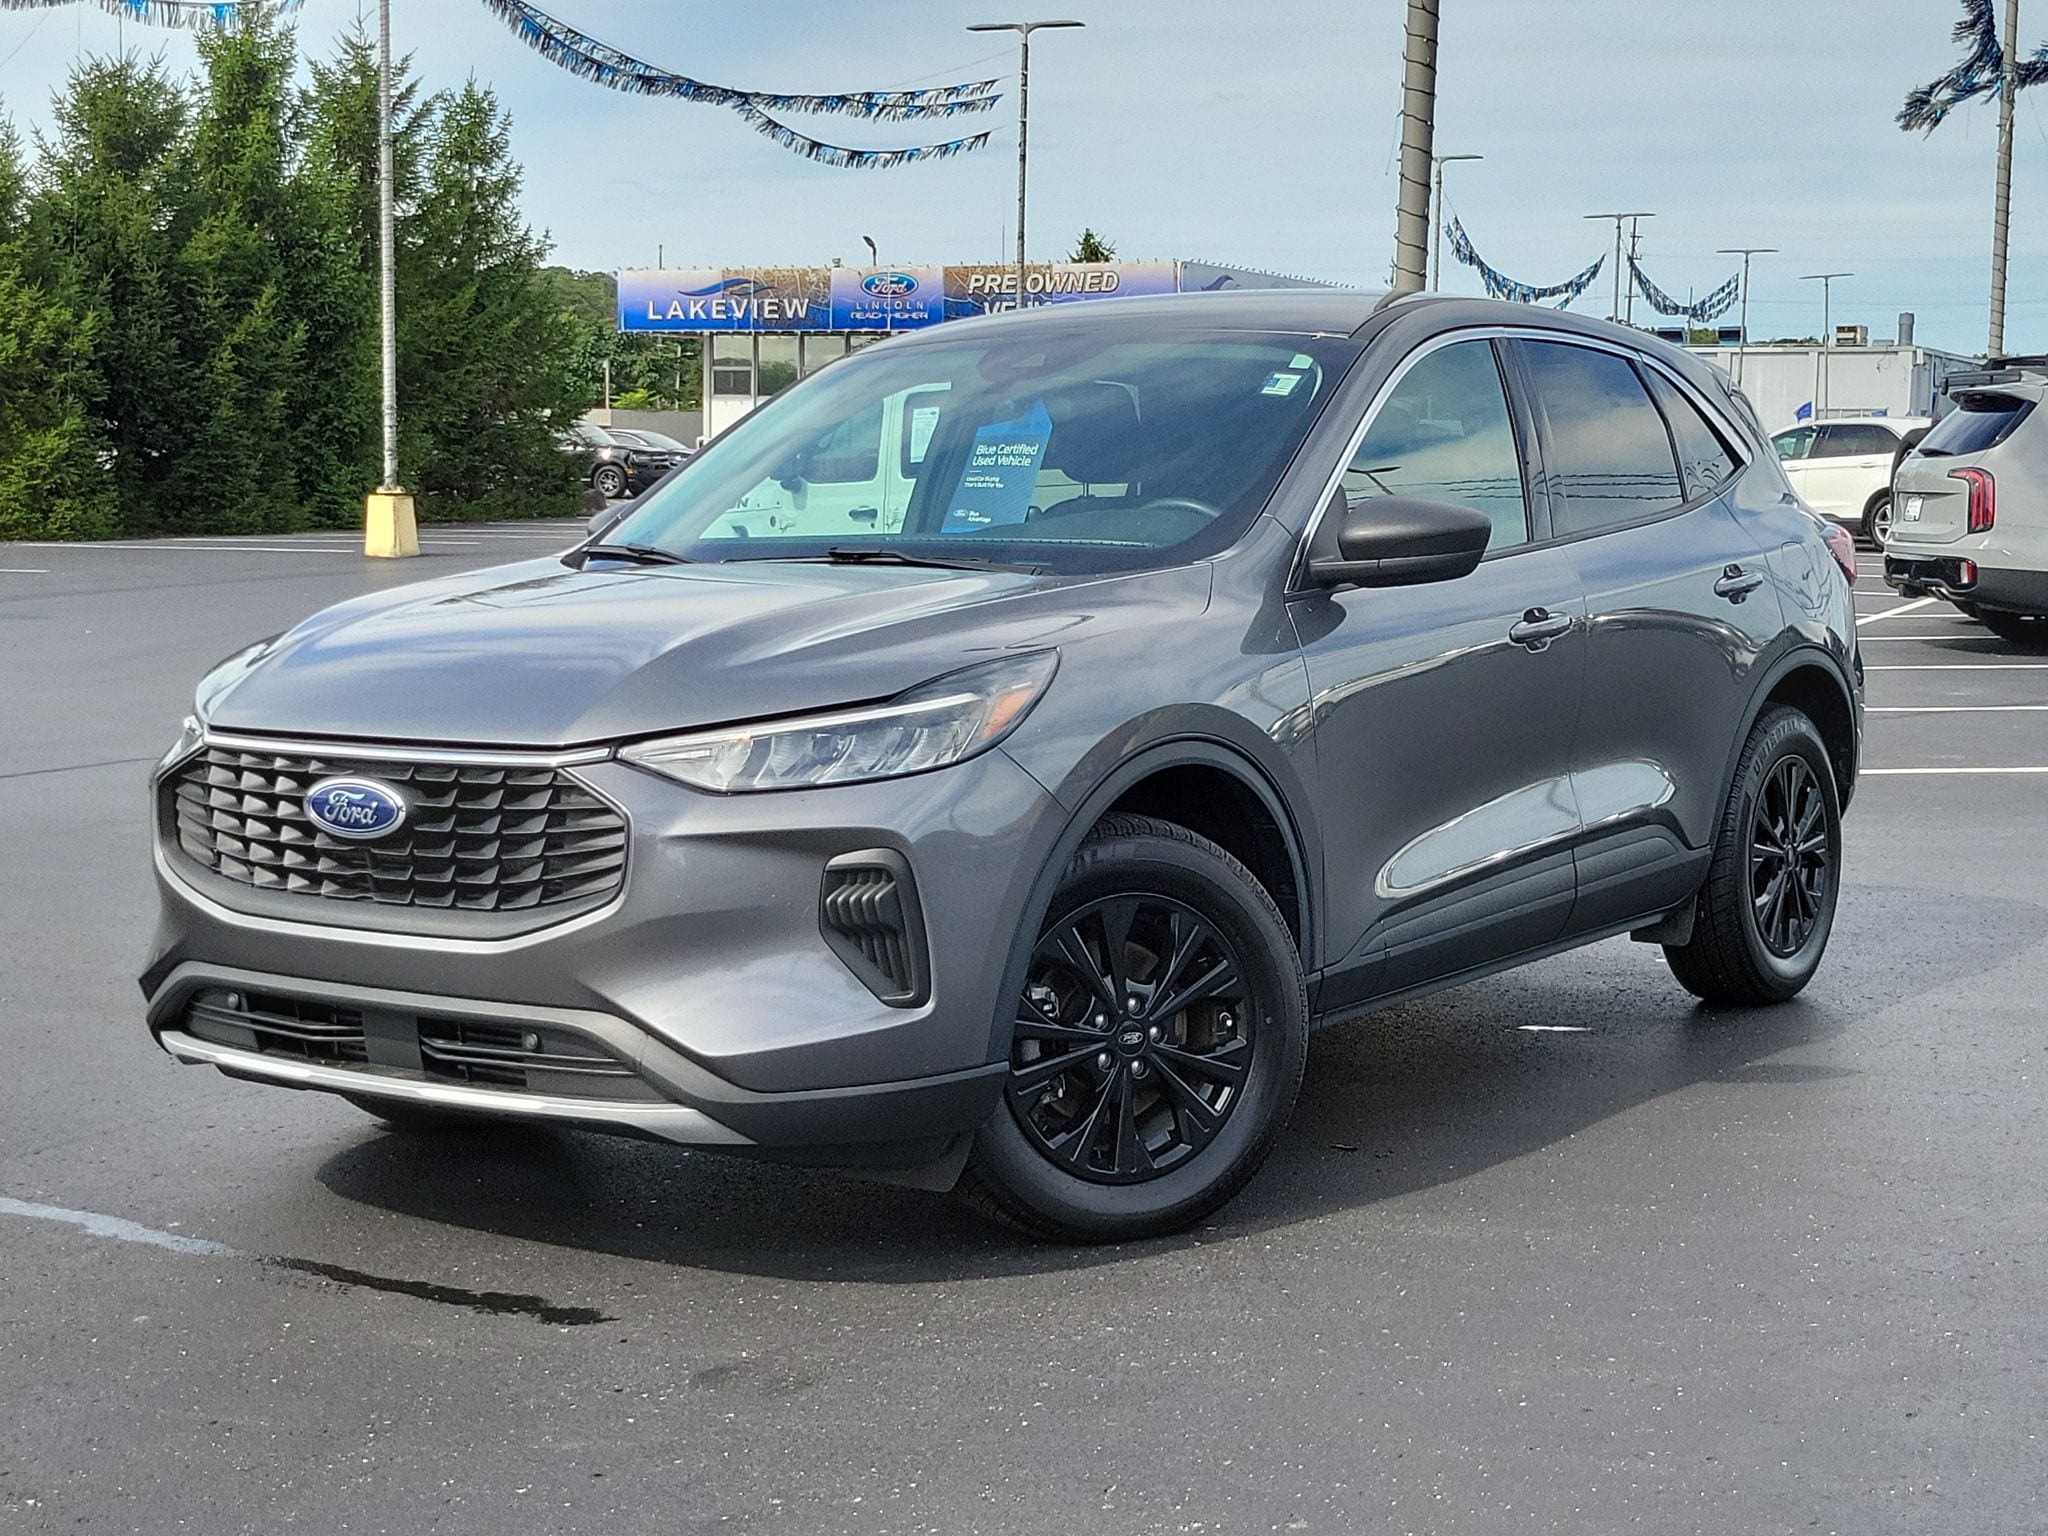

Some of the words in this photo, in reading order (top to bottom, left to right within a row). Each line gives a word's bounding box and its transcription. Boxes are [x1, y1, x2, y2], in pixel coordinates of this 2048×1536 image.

[870, 275, 908, 295] Ford
[967, 274, 1018, 295] PRE
[1025, 271, 1120, 293] OWNED
[647, 298, 811, 321] LAKEVIEW
[855, 300, 924, 310] LINCOLN
[975, 444, 997, 456] Blue
[997, 443, 1040, 456] Certified
[972, 455, 996, 467] Used
[996, 455, 1032, 467] Vehicle
[323, 789, 380, 826] Ford
